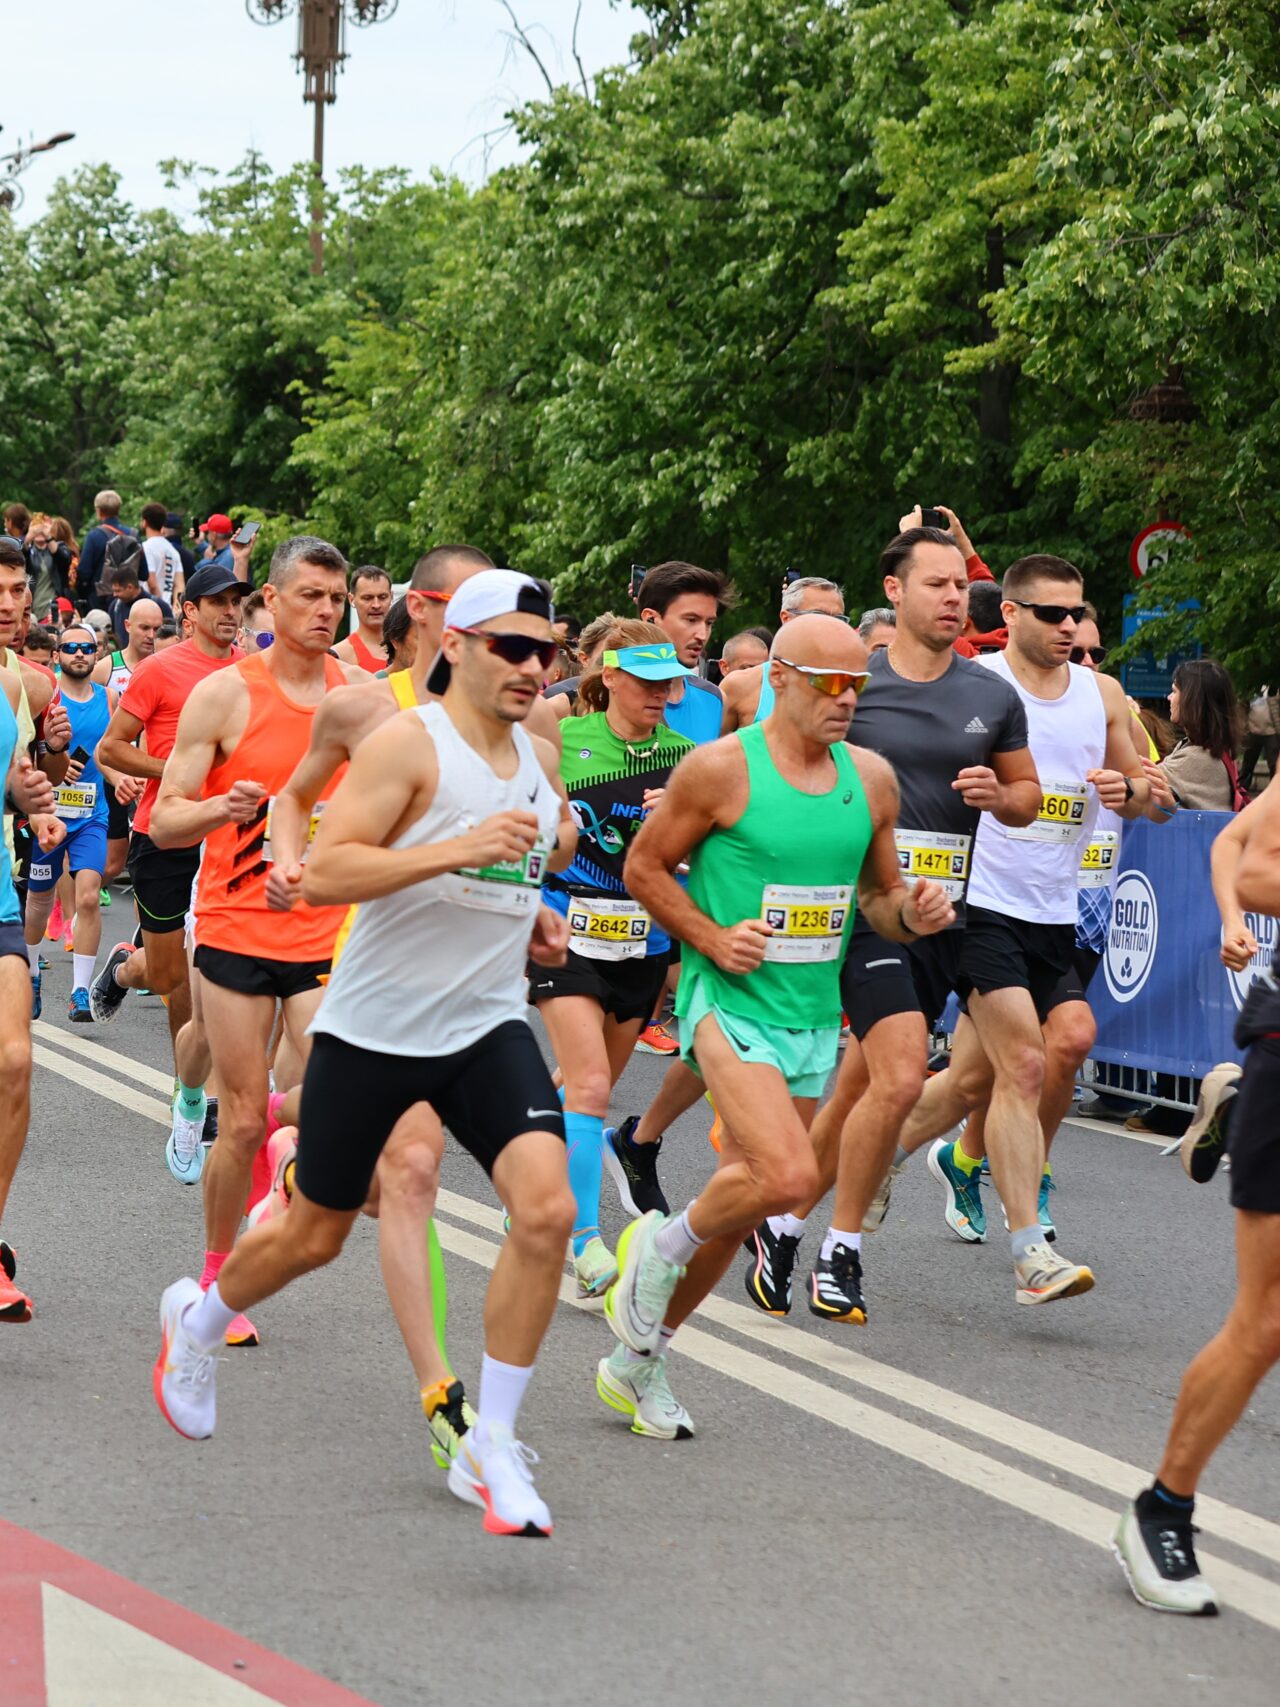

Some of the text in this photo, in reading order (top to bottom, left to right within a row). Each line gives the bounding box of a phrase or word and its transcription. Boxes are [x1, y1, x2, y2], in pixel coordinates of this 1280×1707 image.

[61, 792, 84, 803] 1055
[915, 853, 950, 870] 1471
[30, 867, 50, 877] 055
[790, 910, 829, 928] 1236
[1115, 898, 1149, 930] GOLD
[590, 918, 629, 934] 2642
[1244, 912, 1273, 944] OLD
[1110, 928, 1150, 953] NUTRITION
